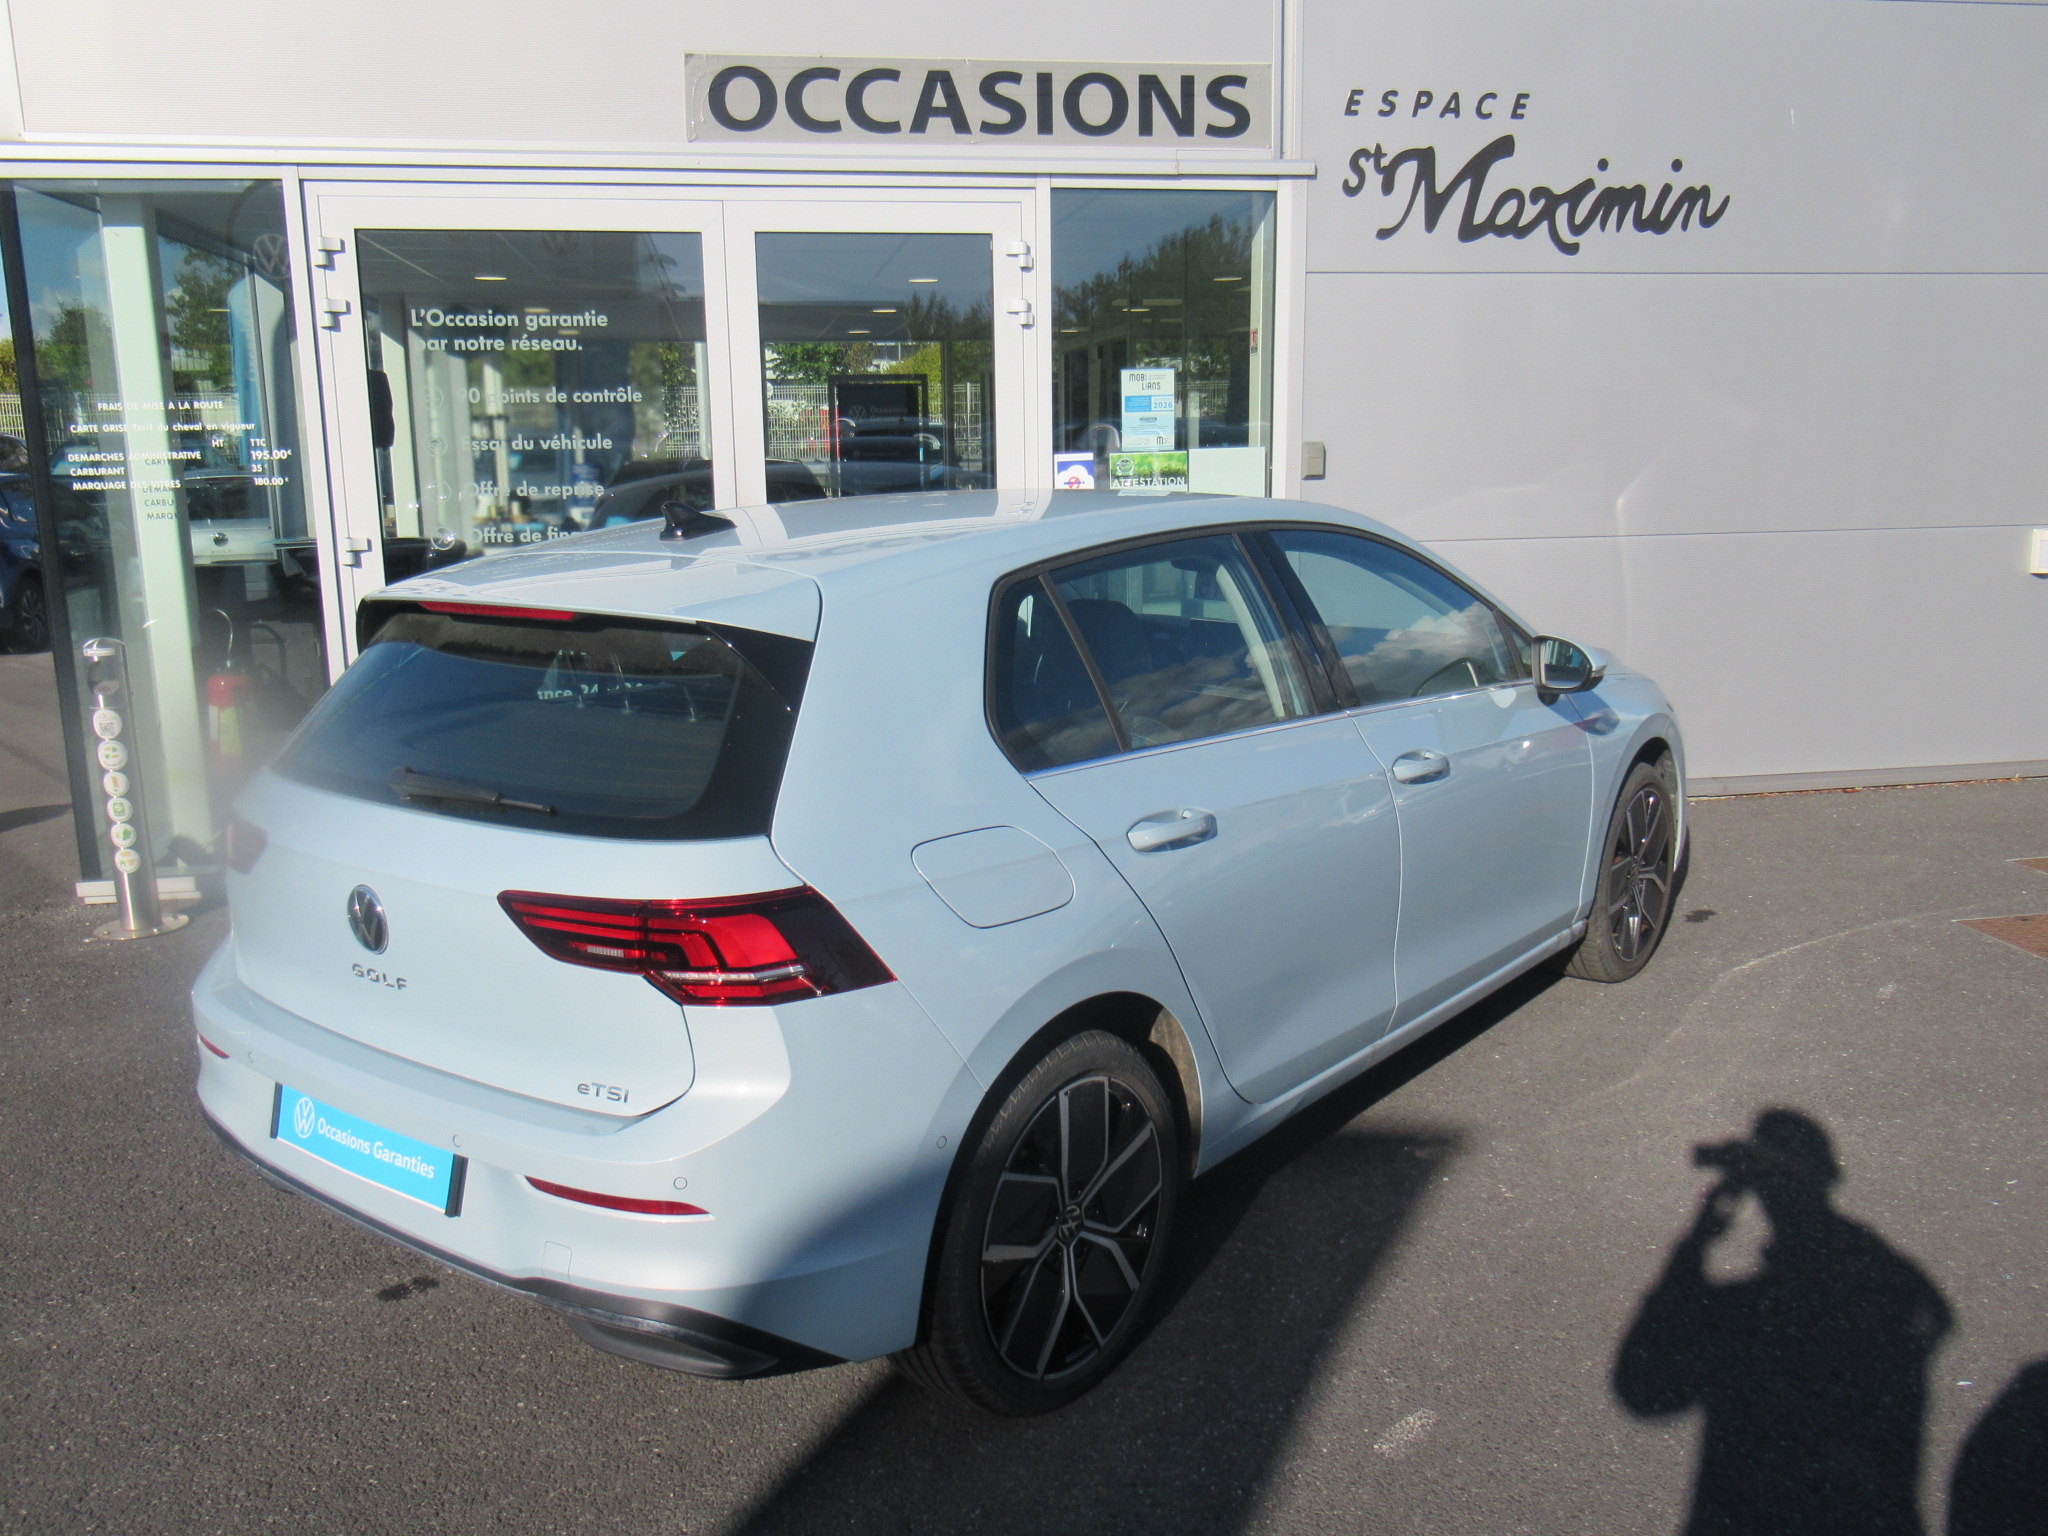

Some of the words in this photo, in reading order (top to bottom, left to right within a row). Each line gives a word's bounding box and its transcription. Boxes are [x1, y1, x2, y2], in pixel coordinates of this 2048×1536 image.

[708, 65, 1251, 138] OCCASIONS
[1344, 89, 1530, 120] ESPACE
[1341, 142, 1388, 198] St
[1375, 134, 1731, 256] Maximin
[411, 308, 519, 327] L'Occasion
[525, 309, 609, 332] garantie
[454, 335, 505, 351] notre
[512, 334, 584, 351] réseau.
[545, 386, 568, 403] de
[572, 385, 643, 403] contrôle
[97, 402, 123, 411] FRAIS
[143, 402, 165, 411] MISE
[168, 401, 176, 410] A
[178, 401, 190, 410] LA
[194, 401, 223, 410] ROUTE
[1153, 401, 1173, 409] 2026
[70, 424, 99, 433] CARTE
[102, 424, 127, 433] GRISE
[157, 423, 169, 432] du
[172, 422, 202, 432] cheval
[222, 422, 255, 433] vigueur
[211, 439, 225, 448] HT
[250, 438, 266, 447] TTC
[511, 434, 534, 450] du
[540, 432, 613, 450] véhicule
[67, 452, 125, 462] DEMARCHES
[129, 451, 202, 461] ADMINISTRATIVE
[70, 467, 126, 476] CARBURANT
[251, 463, 262, 473] 35
[73, 481, 127, 490] MARQUAGE
[150, 479, 182, 489] VITRES
[516, 480, 539, 497] de
[544, 481, 605, 500] reprise
[1112, 476, 1185, 488] ATTESTATION
[471, 527, 514, 543] Offre
[519, 526, 542, 542] de
[352, 963, 408, 991] GOLF
[577, 1081, 630, 1103] eTSI
[317, 1117, 371, 1155] Occasions
[373, 1141, 436, 1179] Garanties
